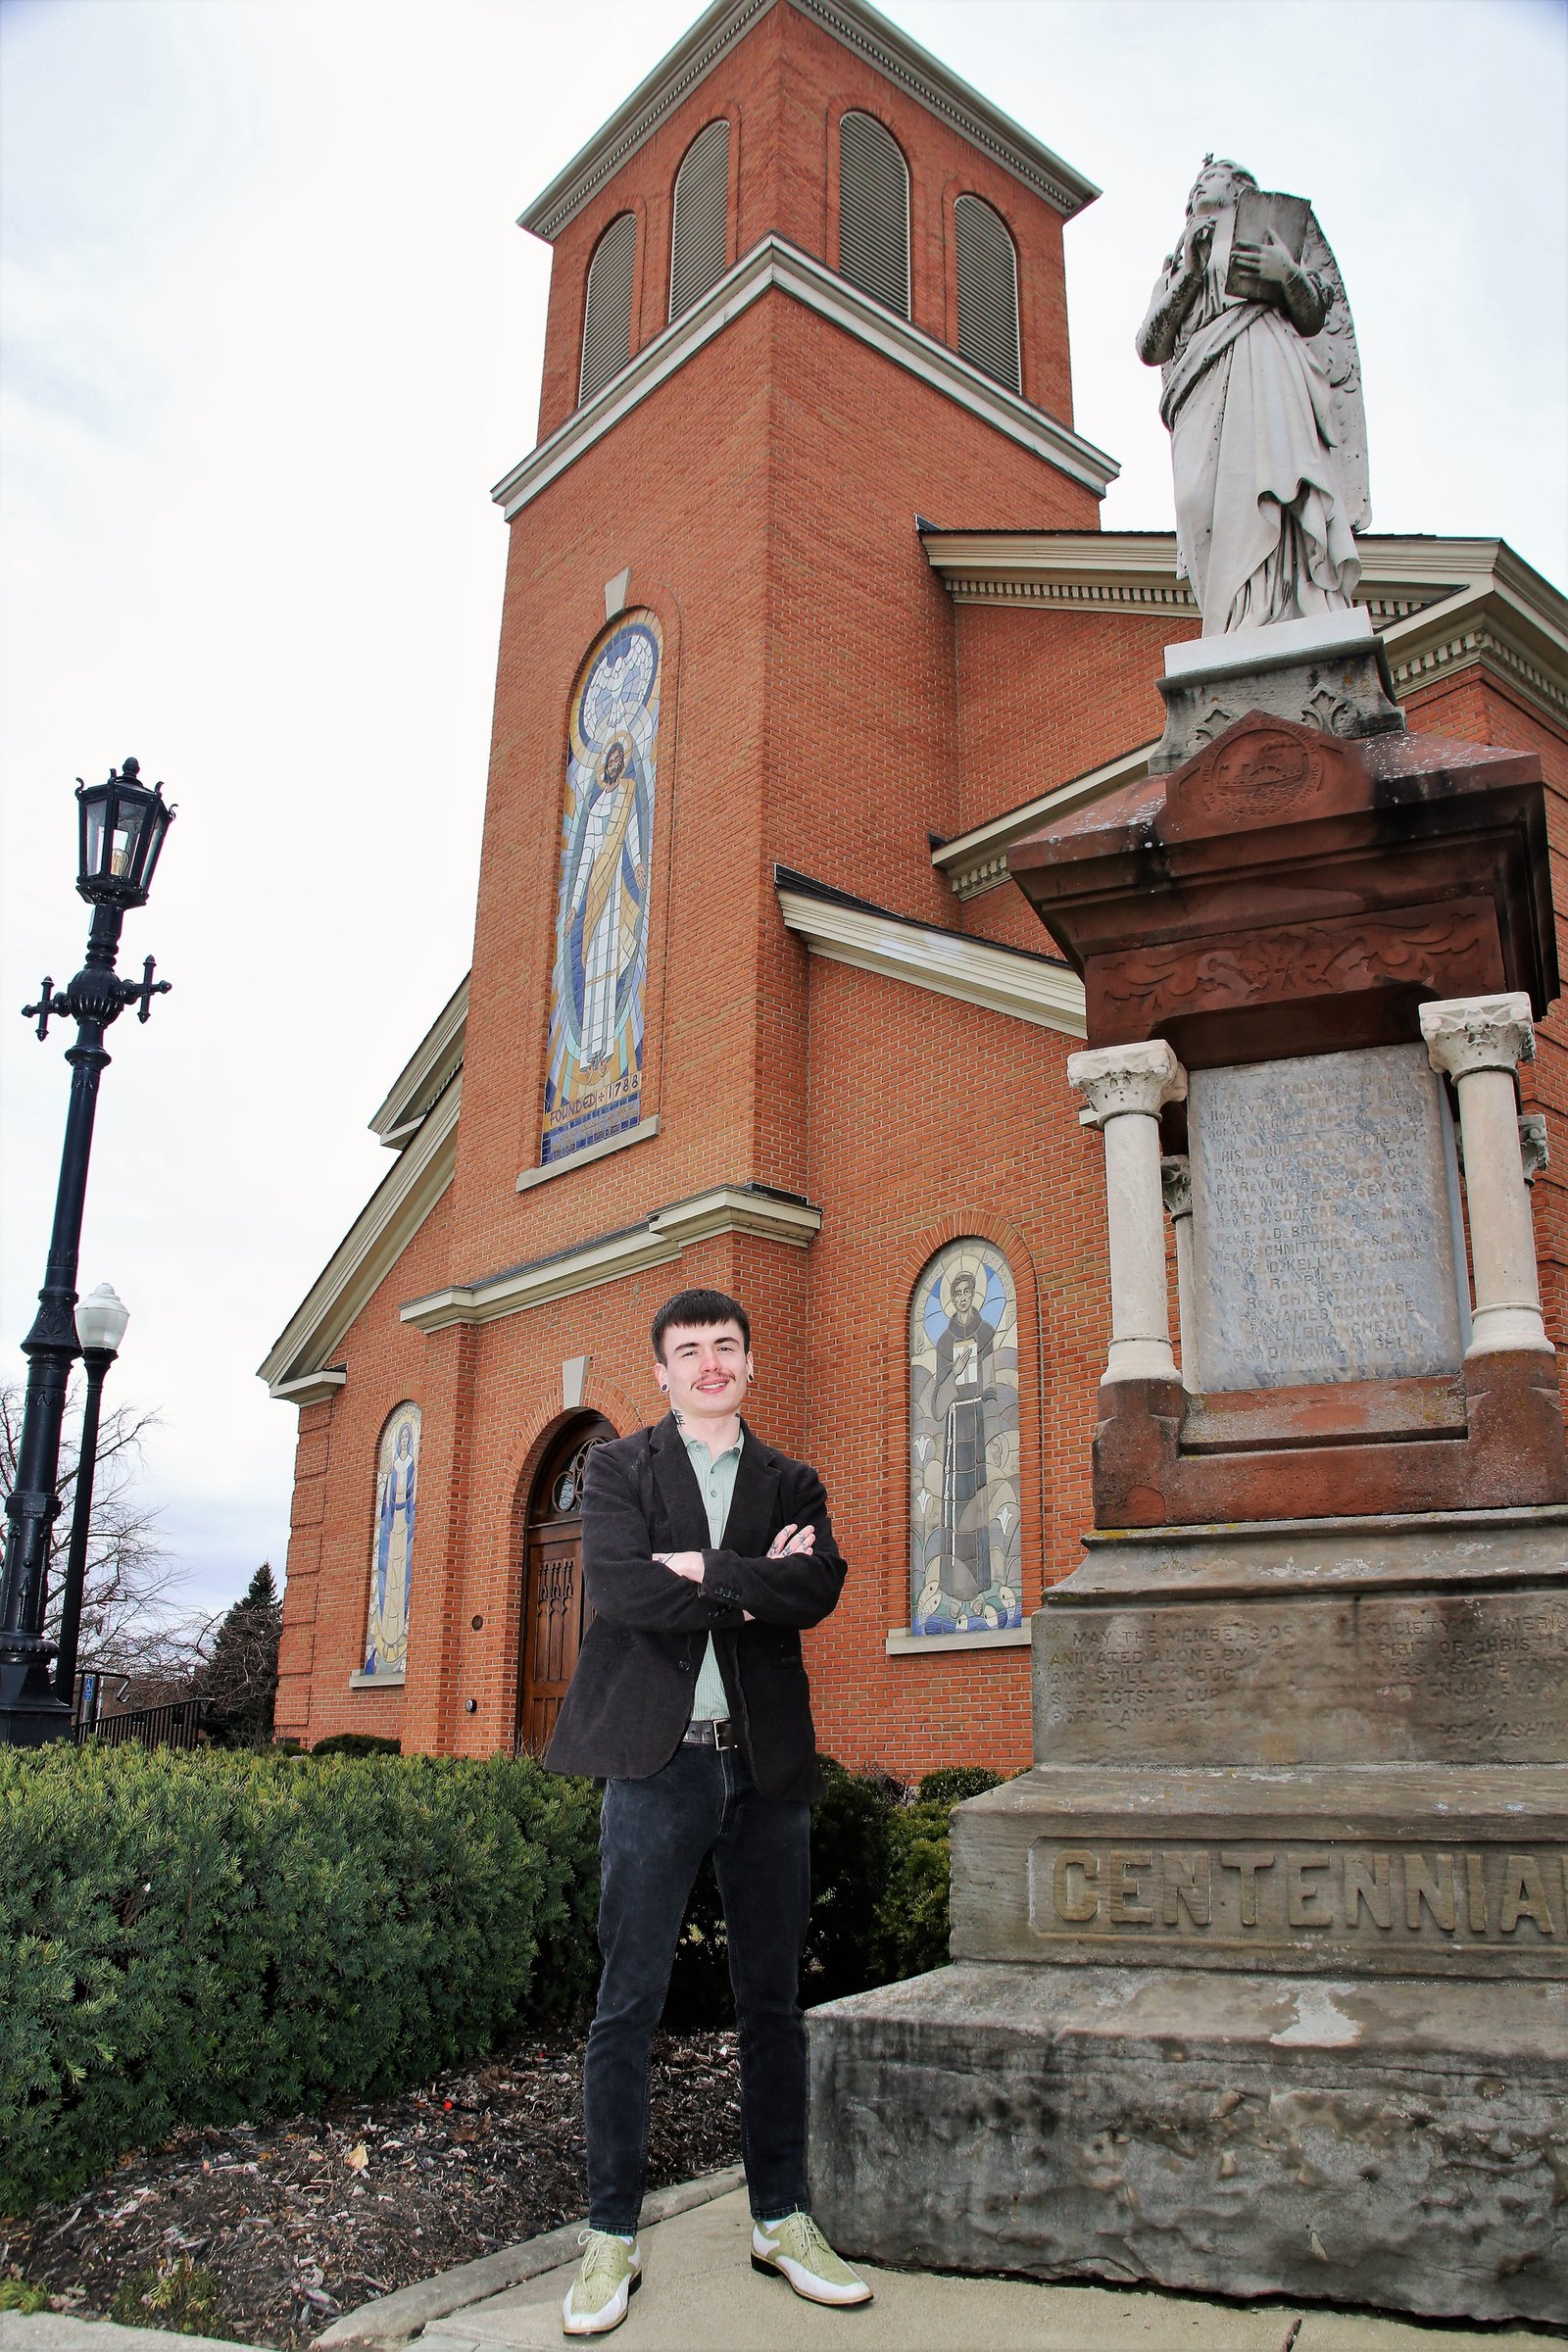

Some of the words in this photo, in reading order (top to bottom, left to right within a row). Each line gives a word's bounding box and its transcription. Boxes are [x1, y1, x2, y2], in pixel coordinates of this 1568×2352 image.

[549, 1093, 597, 1127] FOUNDED
[607, 1074, 639, 1100] 1788
[1245, 1139, 1316, 1159] MONUMENT
[1311, 1182, 1387, 1201] DEMPSEY
[1286, 1255, 1334, 1271] KELLY
[1331, 1283, 1404, 1301] THOMAS
[1270, 1306, 1329, 1324] JAMES
[1302, 1318, 1408, 1339] BRACHEAU
[1073, 1631, 1112, 1646] MAY
[1121, 1630, 1158, 1644] THE
[1366, 1619, 1454, 1637] SOCIETY
[1050, 1650, 1144, 1666] ANIMATED
[1152, 1647, 1216, 1664] ALONE
[1223, 1646, 1248, 1662] BY
[1439, 1639, 1465, 1656] OF
[1052, 1670, 1087, 1685] AND
[1095, 1668, 1151, 1685] STILL
[1051, 1688, 1149, 1705] SUBJECTS
[1053, 1846, 1568, 1936] CENTENNIA
